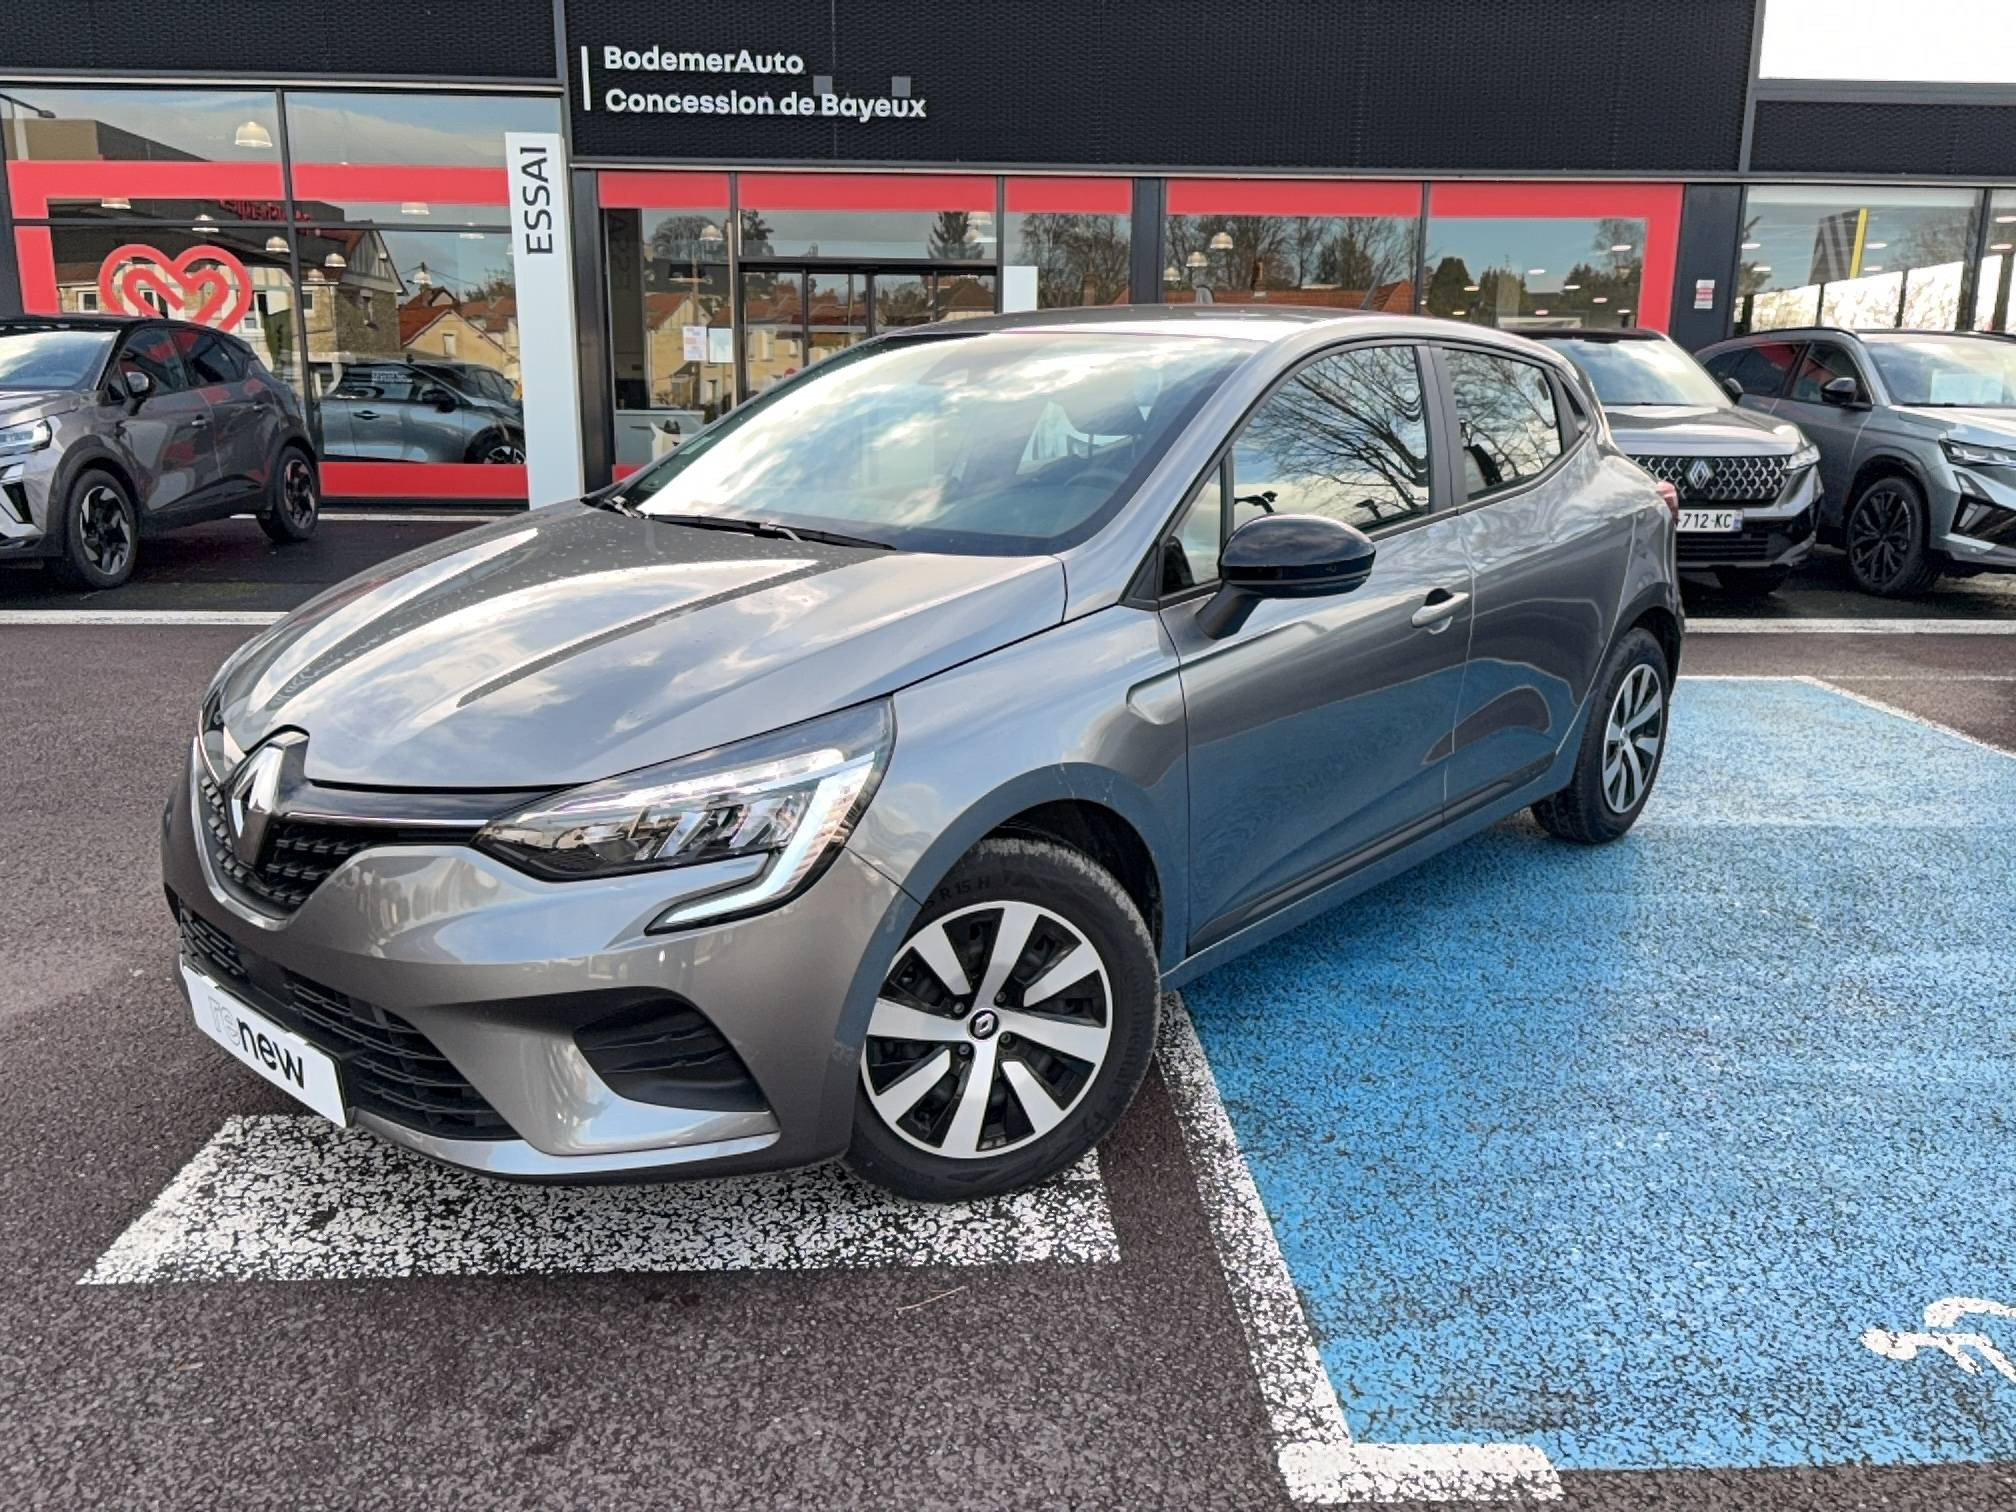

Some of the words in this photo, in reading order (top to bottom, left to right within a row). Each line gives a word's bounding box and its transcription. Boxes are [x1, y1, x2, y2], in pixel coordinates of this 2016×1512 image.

[603, 45, 804, 74] BodemerAuto
[605, 88, 774, 114] Concession
[779, 91, 815, 116] de
[821, 93, 927, 123] Bayeux
[520, 146, 553, 255] ESSAI
